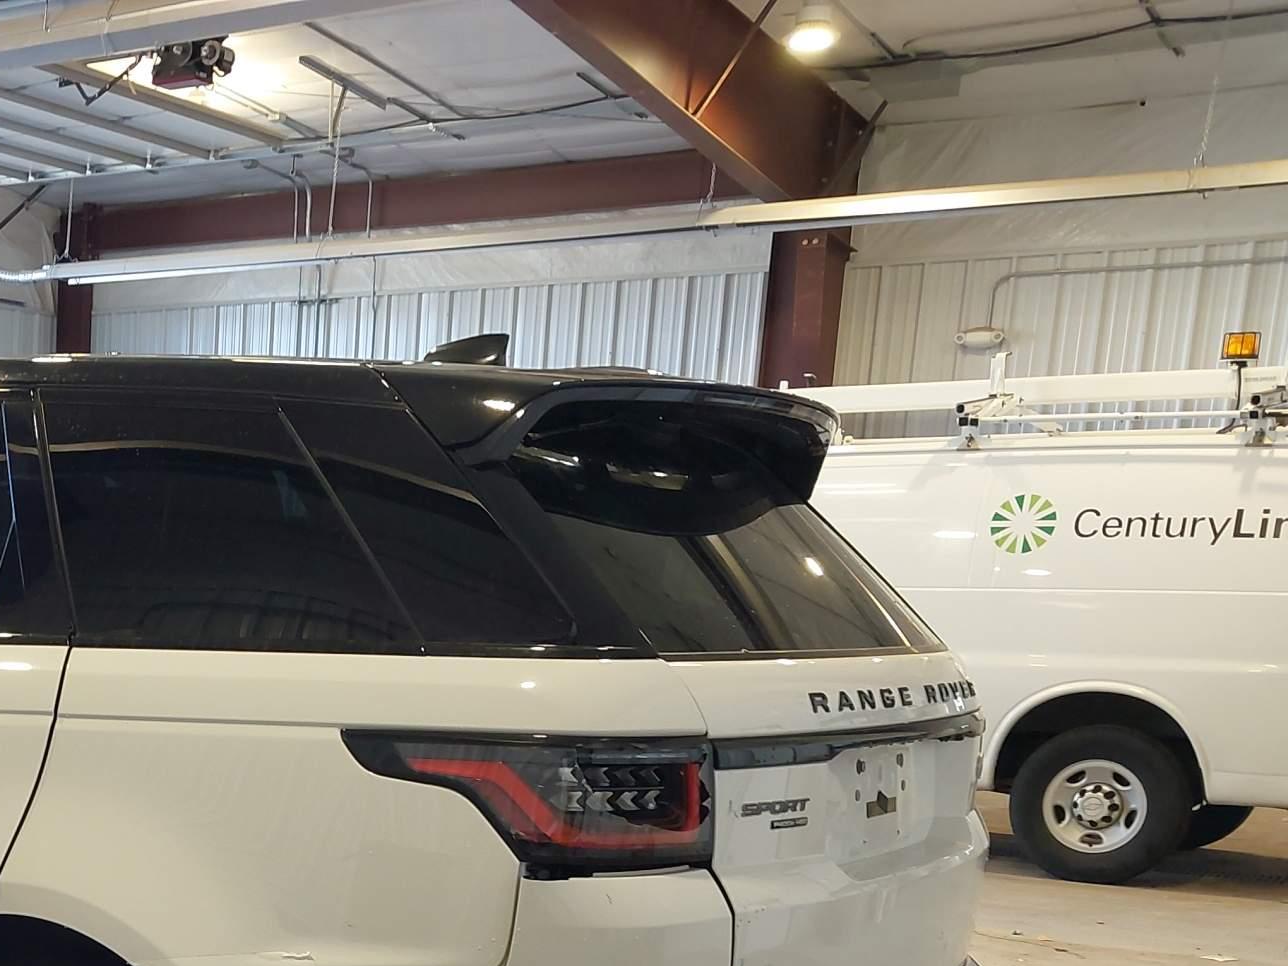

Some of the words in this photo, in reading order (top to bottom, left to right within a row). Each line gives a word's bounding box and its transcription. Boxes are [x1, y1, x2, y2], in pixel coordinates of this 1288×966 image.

[808, 686, 914, 714] RANGE
[923, 679, 977, 705] ROVER
[740, 797, 810, 818] SPORT
